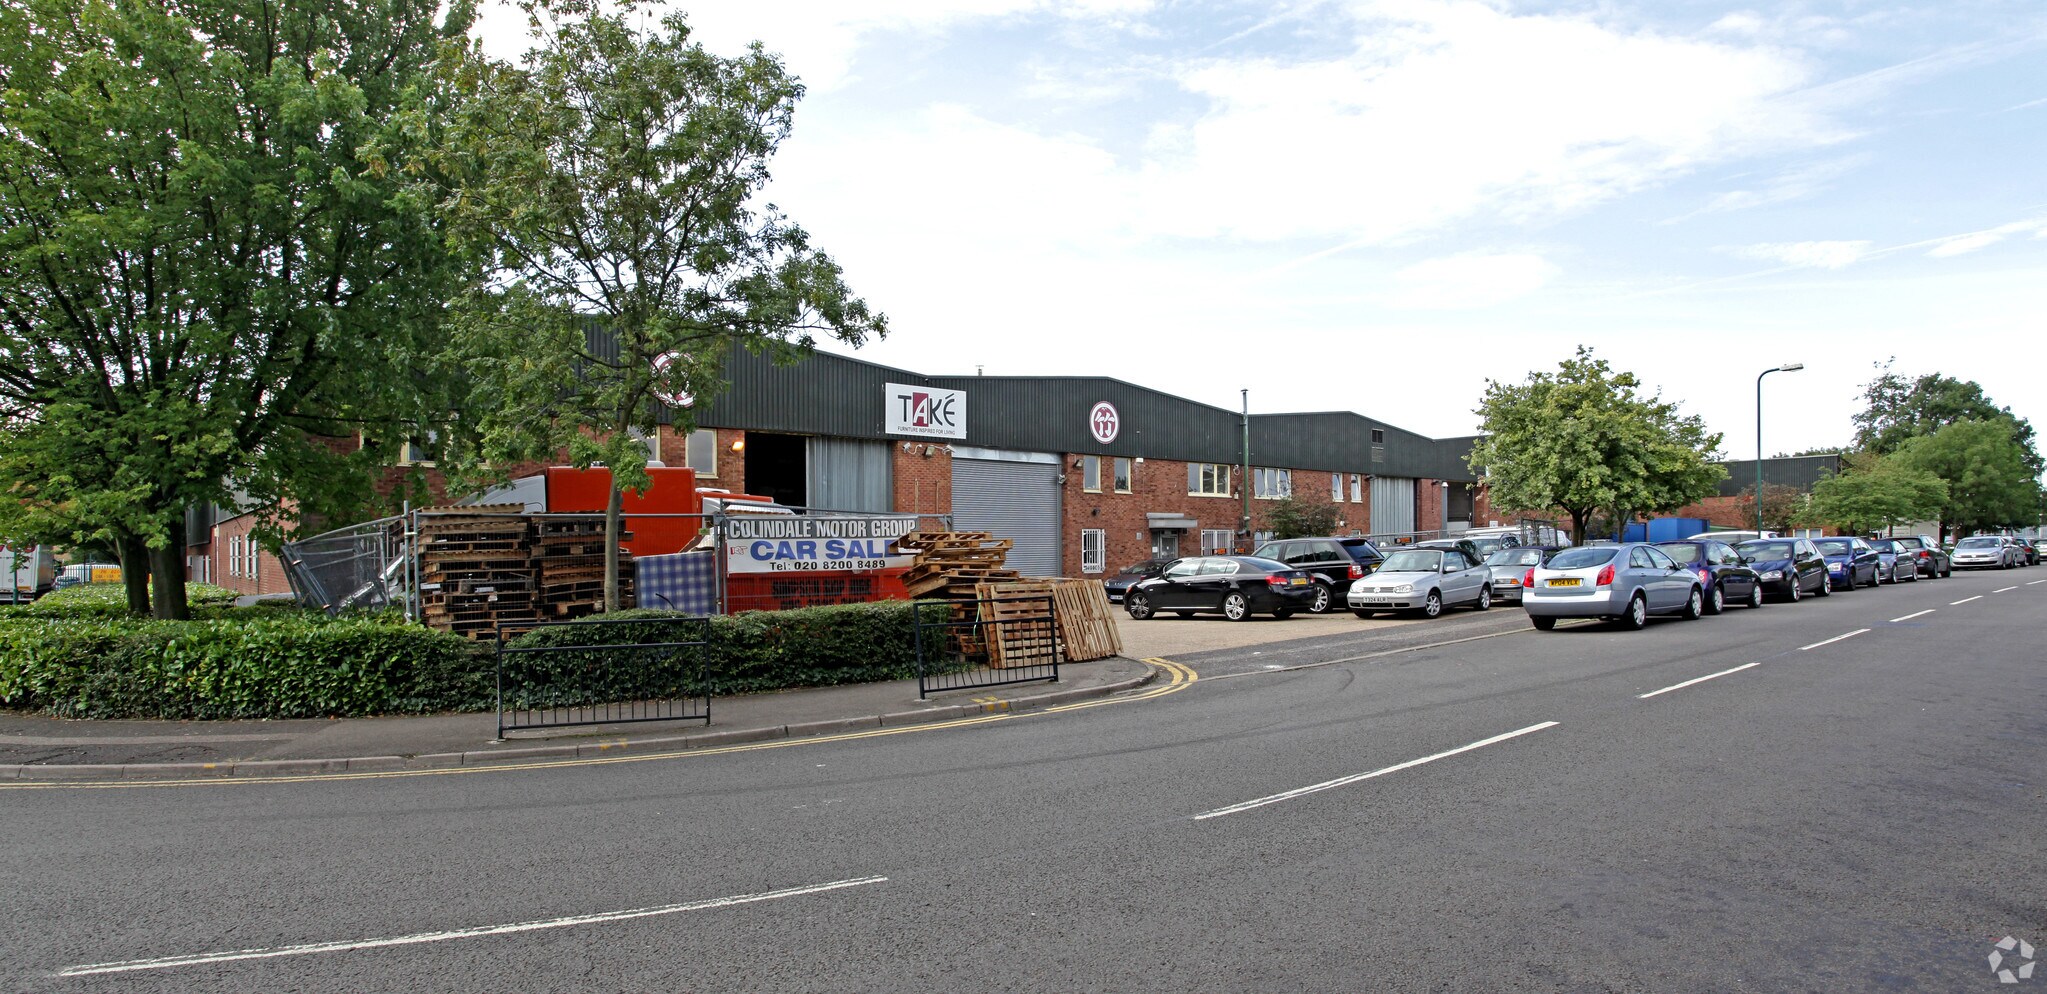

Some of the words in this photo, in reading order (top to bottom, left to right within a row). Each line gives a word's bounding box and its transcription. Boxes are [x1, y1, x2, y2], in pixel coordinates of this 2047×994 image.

[898, 393, 955, 427] TAKÉ
[730, 520, 812, 538] COLINDALE
[816, 520, 867, 537] MOTOR
[871, 519, 916, 537] GROUP
[750, 540, 817, 561] CAR
[770, 562, 790, 571] Tel:
[794, 561, 818, 570] 020
[823, 560, 853, 569] 8200
[857, 559, 886, 569] 8489
